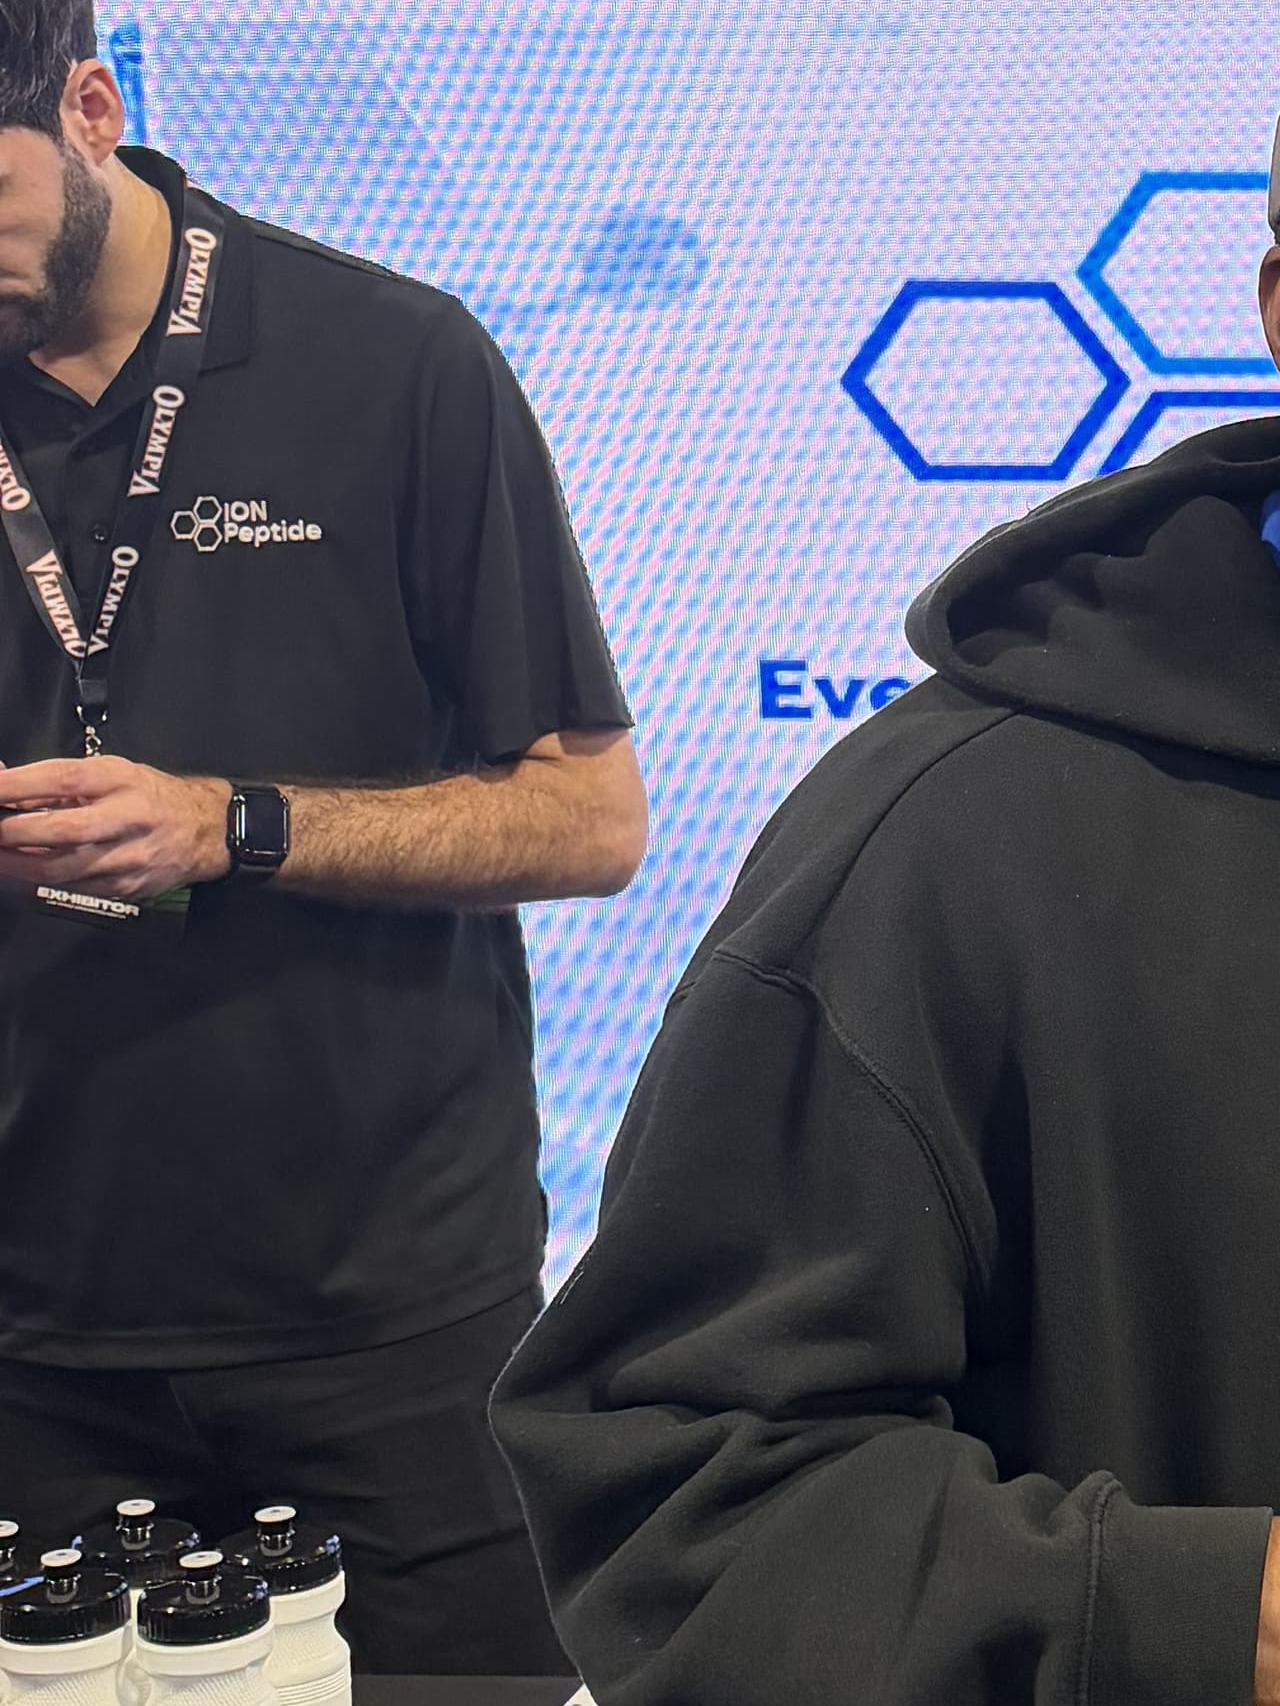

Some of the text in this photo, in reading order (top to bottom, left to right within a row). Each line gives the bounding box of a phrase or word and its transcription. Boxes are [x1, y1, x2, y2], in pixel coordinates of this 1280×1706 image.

[167, 227, 217, 337] OLYMPIA
[127, 385, 185, 497] OLYMPIA
[224, 500, 267, 523] ION
[224, 519, 322, 547] Peptide
[26, 549, 88, 658] OLYMPIA
[86, 545, 140, 656] OLYMPIA
[36, 886, 141, 917] EXHIBITOR
